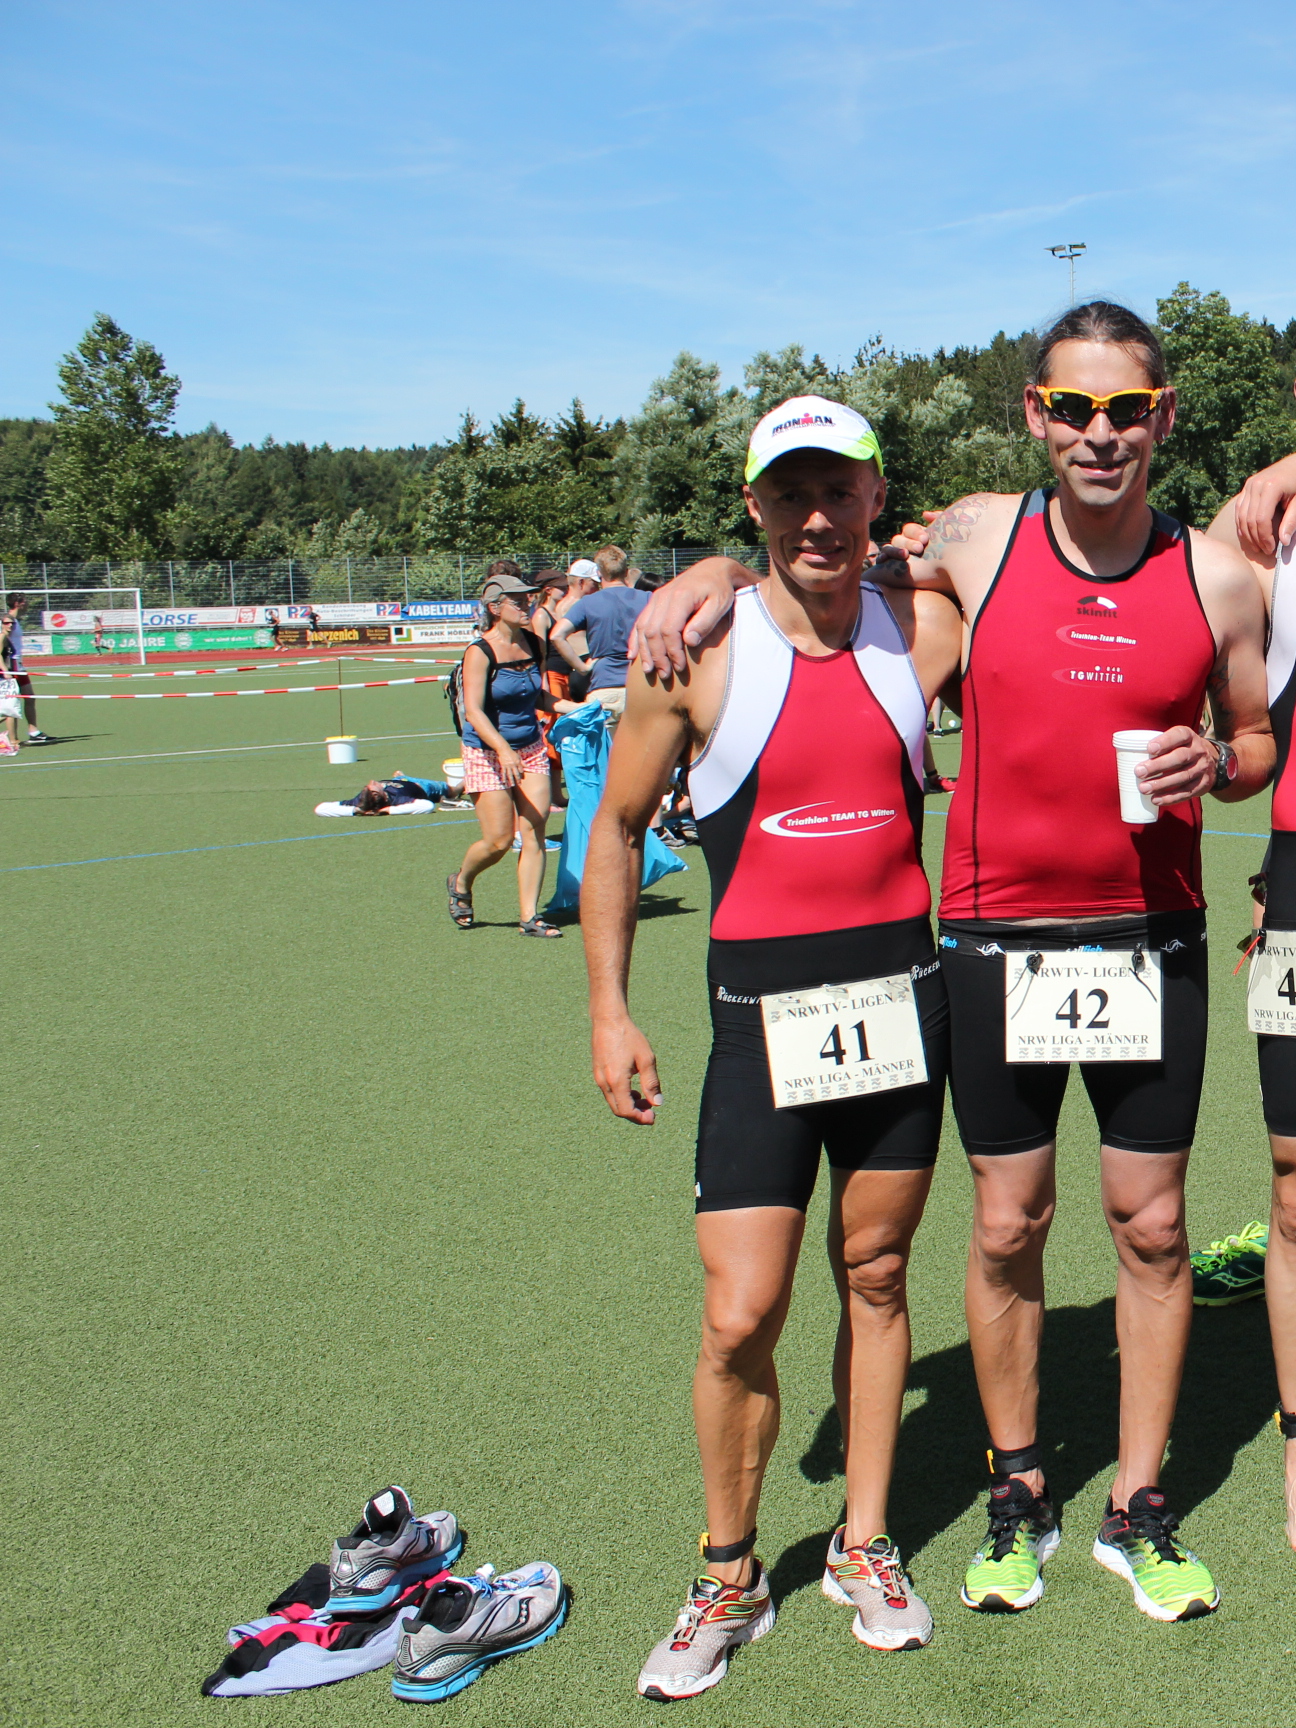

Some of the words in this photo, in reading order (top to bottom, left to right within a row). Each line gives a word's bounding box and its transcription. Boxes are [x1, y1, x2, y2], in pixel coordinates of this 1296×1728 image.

[772, 412, 833, 434] IRONMAN
[142, 610, 198, 626] LORSE
[409, 604, 472, 616] KABELTEAM
[1076, 607, 1118, 618] skinfit
[786, 815, 828, 827] Triathlon
[831, 811, 855, 822] TEAM
[857, 810, 869, 819] TG
[871, 808, 895, 817] Witten
[787, 1002, 847, 1019] NRWTV-
[851, 993, 894, 1010] LIGEN
[1055, 988, 1111, 1029] 42
[1253, 1009, 1274, 1019] NRW
[819, 1019, 876, 1066] 41
[1018, 1035, 1049, 1046] NRW
[1051, 1035, 1083, 1046] LIGA
[1094, 1032, 1149, 1045] MÄNNER
[784, 1076, 815, 1090] NRW
[820, 1071, 851, 1085] LIGA
[862, 1059, 915, 1077] MÄNNER
